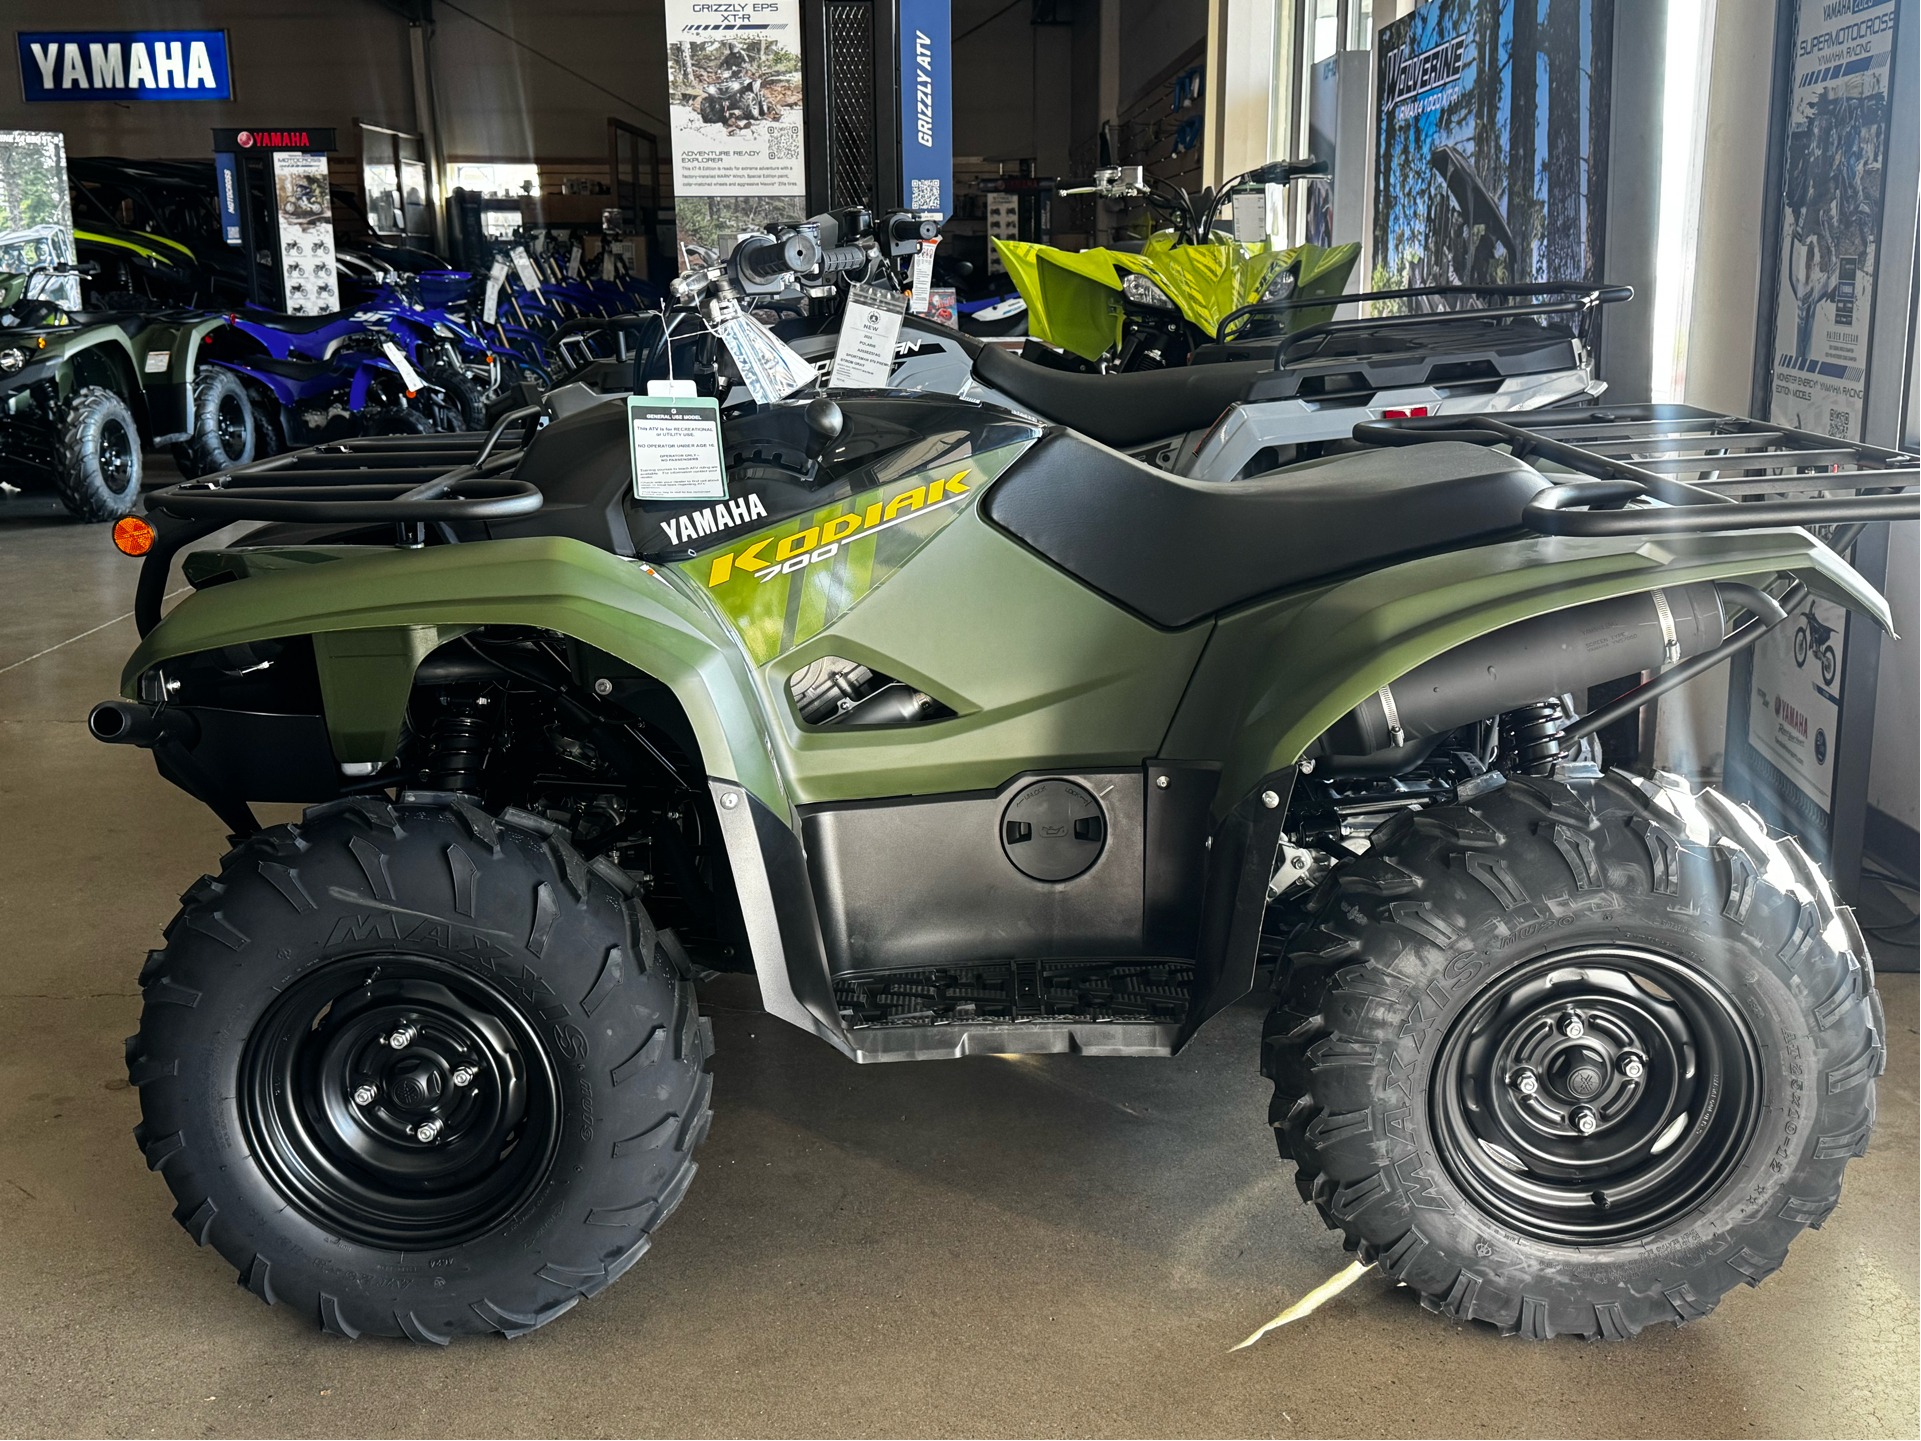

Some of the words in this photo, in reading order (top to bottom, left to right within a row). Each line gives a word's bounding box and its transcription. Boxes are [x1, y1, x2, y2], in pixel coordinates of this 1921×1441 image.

[692, 3, 748, 12] GRIZZLY
[752, 3, 779, 12] EPS
[721, 14, 751, 23] XT-R
[1823, 0, 1851, 21] YAMAHA
[916, 30, 931, 71] ATV
[1799, 10, 1895, 58] SUPERMOTOCROSS
[1817, 49, 1844, 66] YAMAHA
[1846, 40, 1872, 58] RACING
[30, 41, 216, 89] YAMAHA
[1384, 34, 1466, 112] WOLVERINE
[917, 69, 932, 147] GRIZZLY
[254, 132, 310, 147] YAMAHA
[223, 169, 235, 214] MOTOCROSS
[863, 324, 879, 332] NEW
[1777, 372, 1797, 384] MONSTER
[660, 493, 768, 546] YAMAHA
[708, 468, 973, 588] KODIAK
[754, 543, 839, 584] 700
[1781, 699, 1808, 740] YAMAHA
[323, 914, 590, 1060] MAXXIS
[1384, 950, 1484, 1212] MAXXIS
